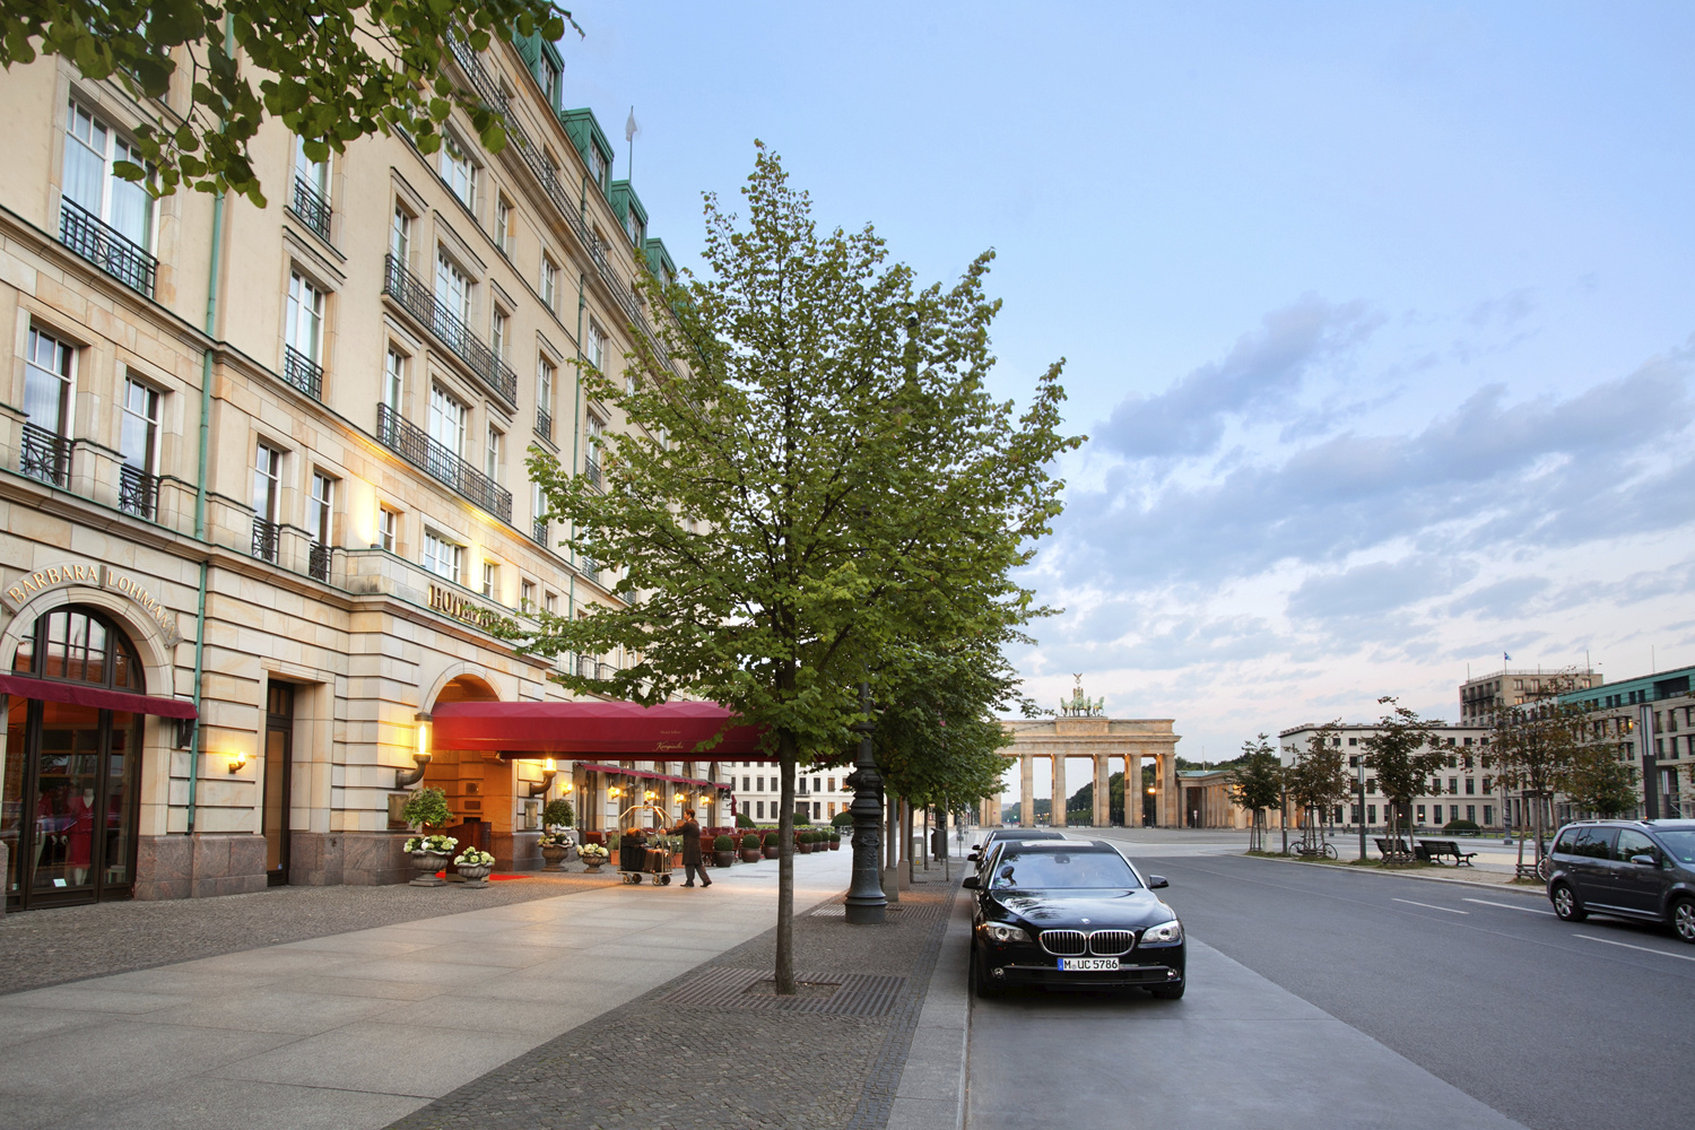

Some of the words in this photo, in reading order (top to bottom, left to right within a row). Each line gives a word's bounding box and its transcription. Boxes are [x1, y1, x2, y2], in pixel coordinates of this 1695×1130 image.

[8, 565, 98, 604] BARBARA
[1064, 960, 1071, 969] M
[1093, 960, 1118, 969] 5786
